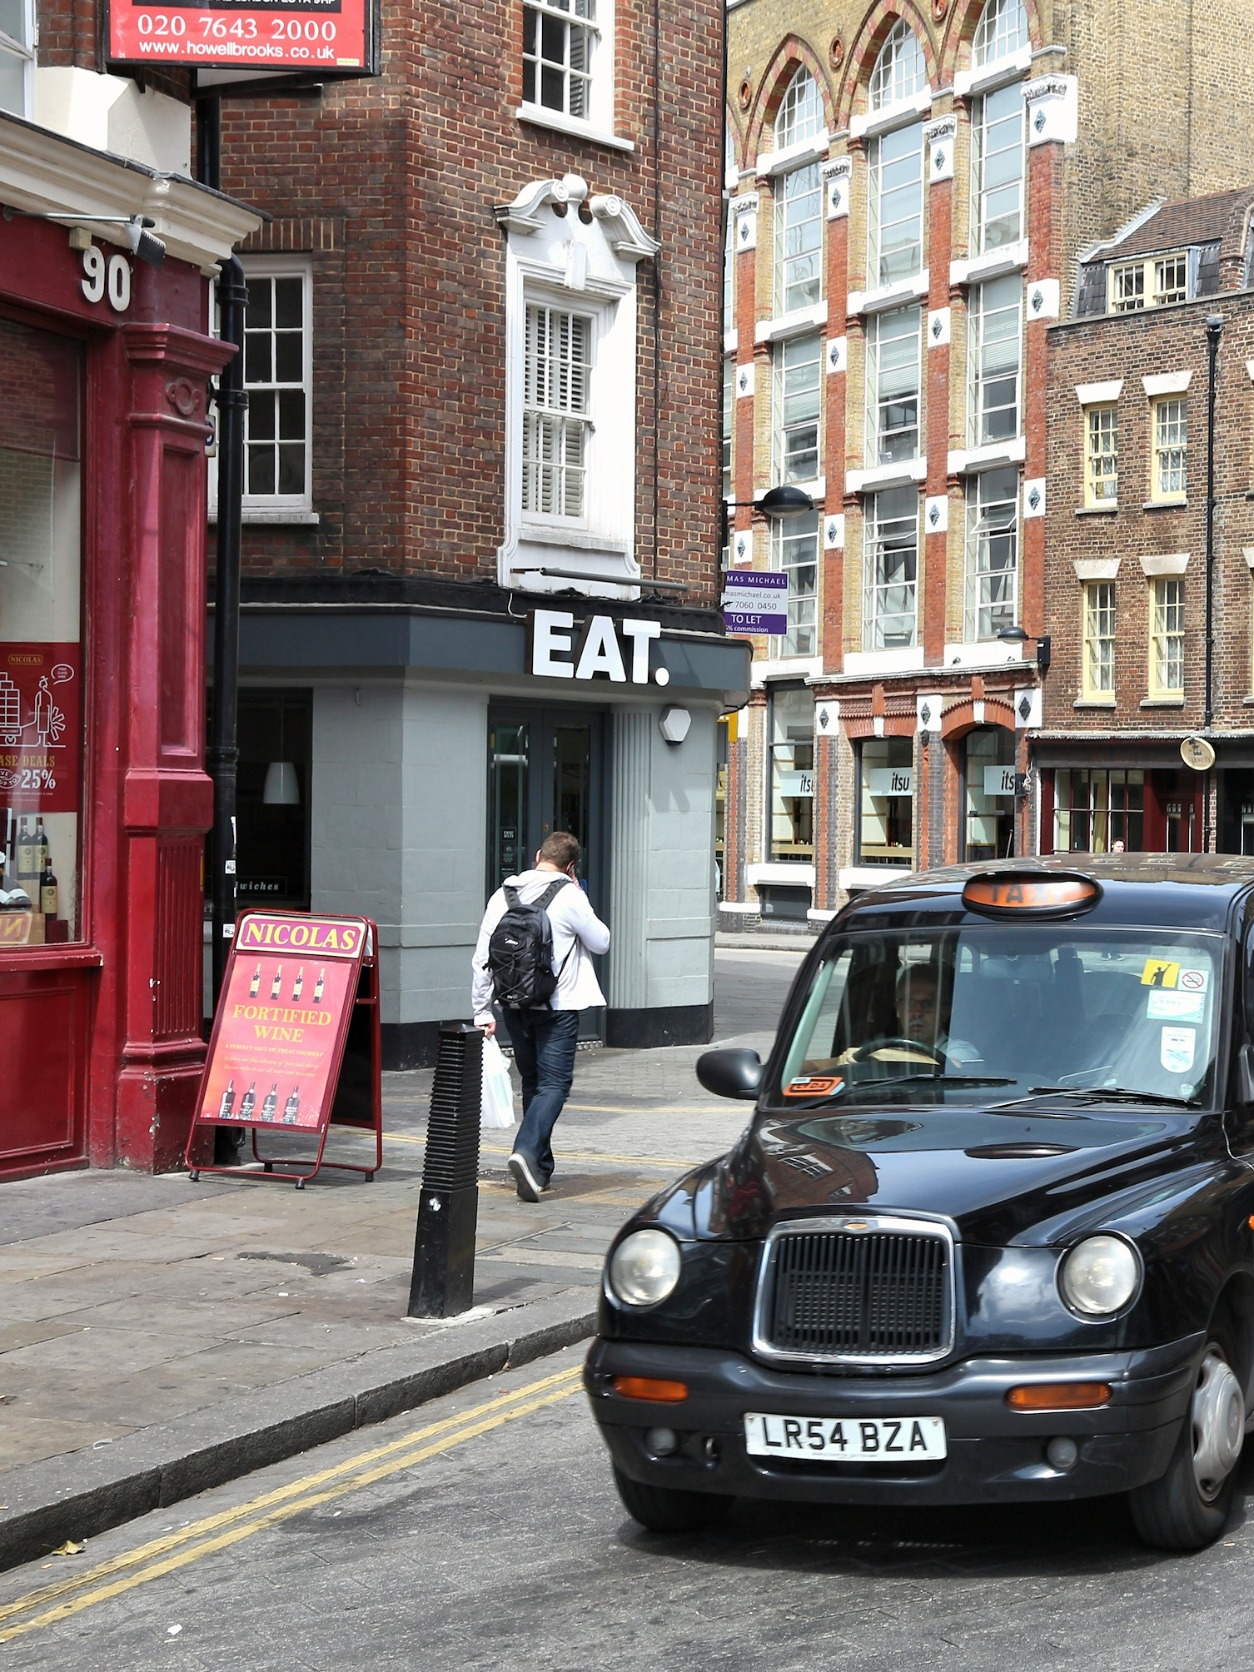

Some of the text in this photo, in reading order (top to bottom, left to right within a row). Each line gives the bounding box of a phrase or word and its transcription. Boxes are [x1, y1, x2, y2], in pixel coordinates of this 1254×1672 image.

[137, 14, 337, 41] 020 7643 2000
[139, 40, 335, 60] www.howellbrooks.co.uk
[81, 246, 132, 312] 90
[747, 576, 786, 585] MICHAEL
[735, 601, 754, 609] 7060
[757, 602, 777, 610] 0450
[731, 614, 762, 625] TO LET
[532, 608, 670, 687] EAT.
[23, 755, 56, 768] DEALS
[21, 769, 57, 790] 25%
[891, 772, 910, 792] itsu
[235, 881, 279, 890] wiches
[245, 922, 357, 950] NICOLAS
[232, 1004, 333, 1026] FORTIFIED
[254, 1025, 304, 1043] WINE
[762, 1417, 928, 1453] LR54 BZA
